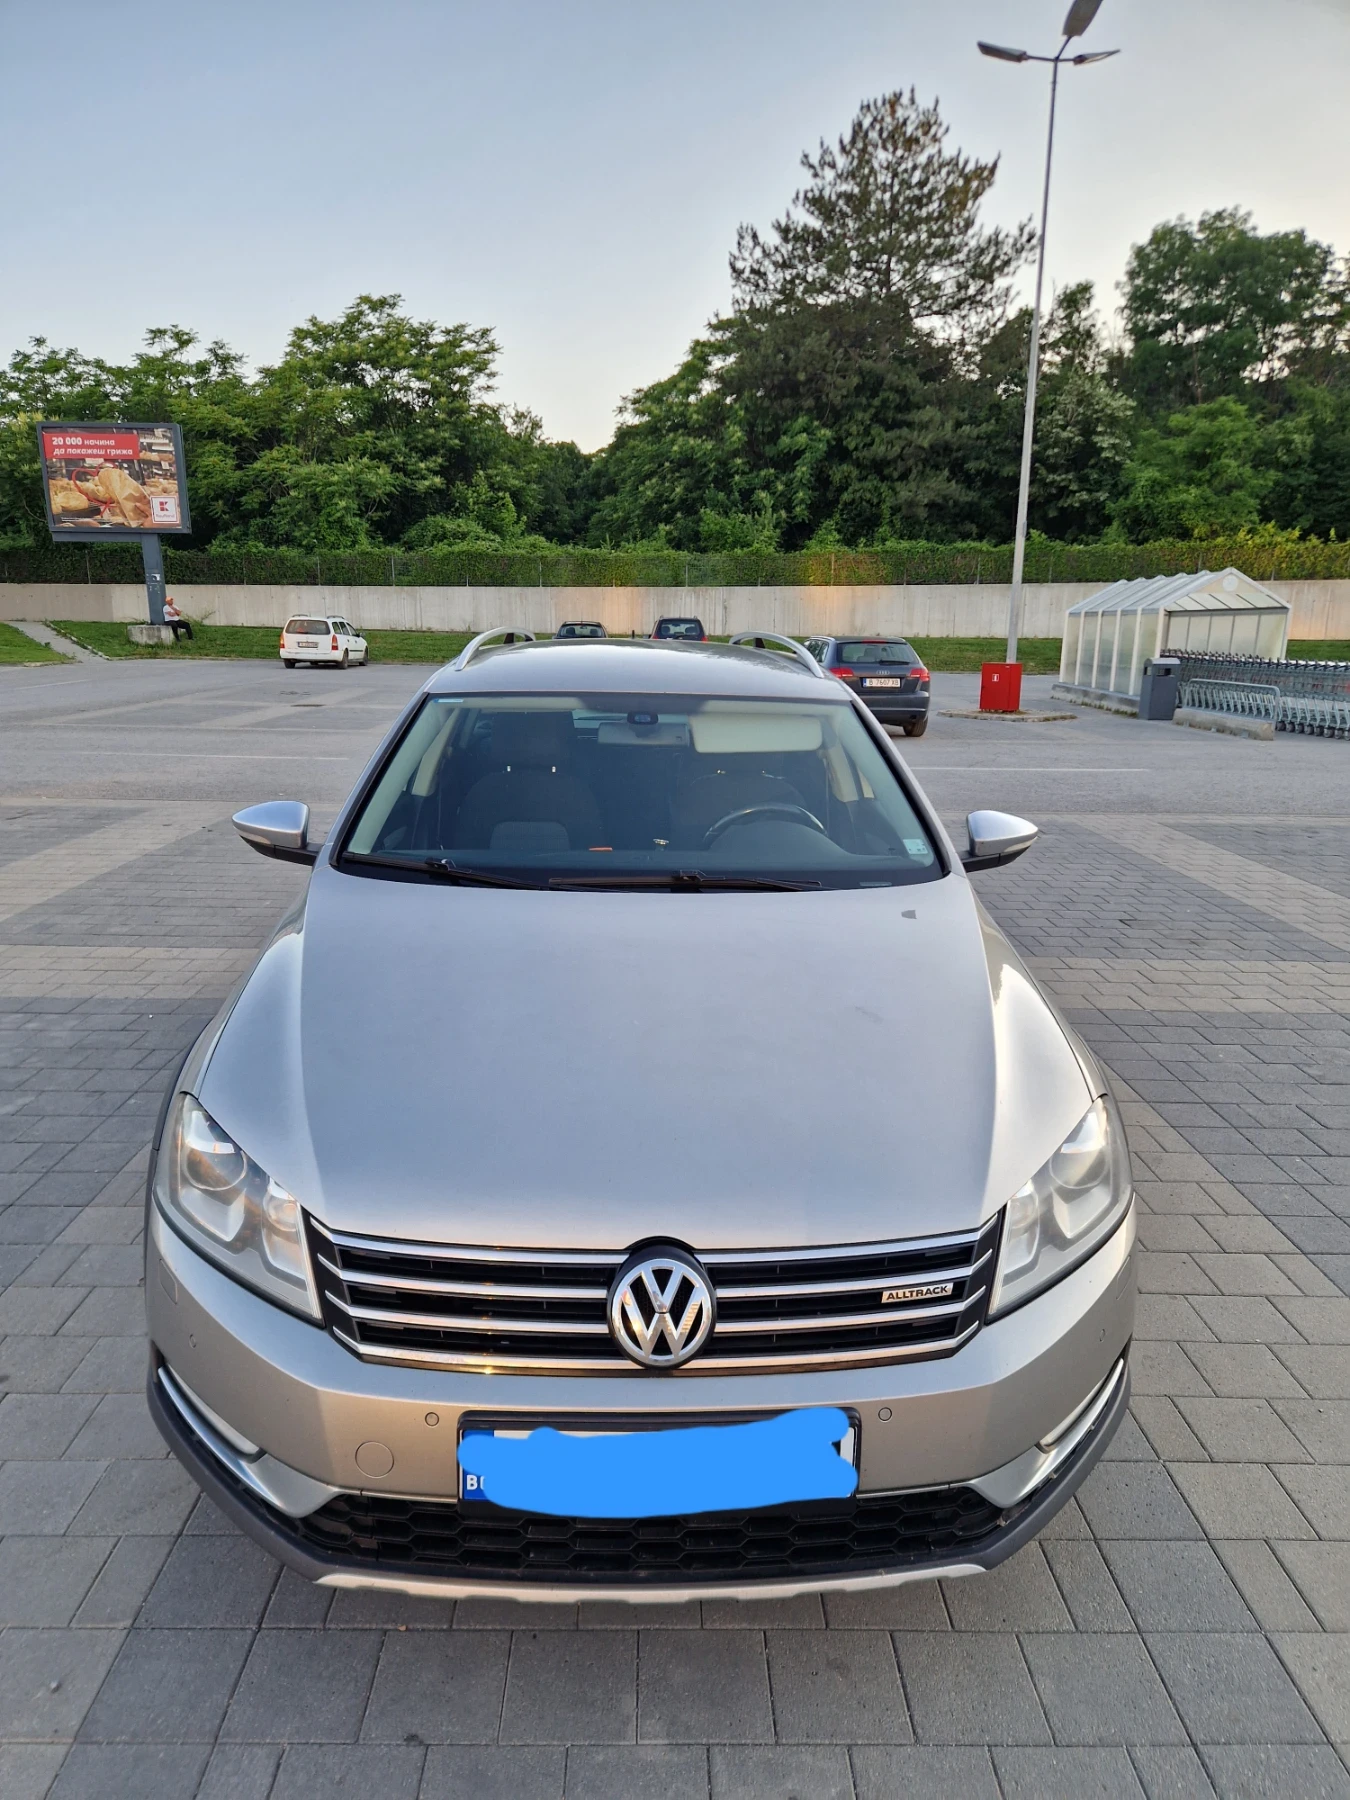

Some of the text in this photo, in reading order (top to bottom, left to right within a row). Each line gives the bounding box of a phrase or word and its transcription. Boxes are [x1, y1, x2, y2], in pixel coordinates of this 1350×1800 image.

[52, 437, 64, 446] 20
[65, 437, 83, 446] 000
[53, 448, 65, 456] да
[886, 1285, 949, 1301] ALLTRACK
[612, 1259, 712, 1367] VW
